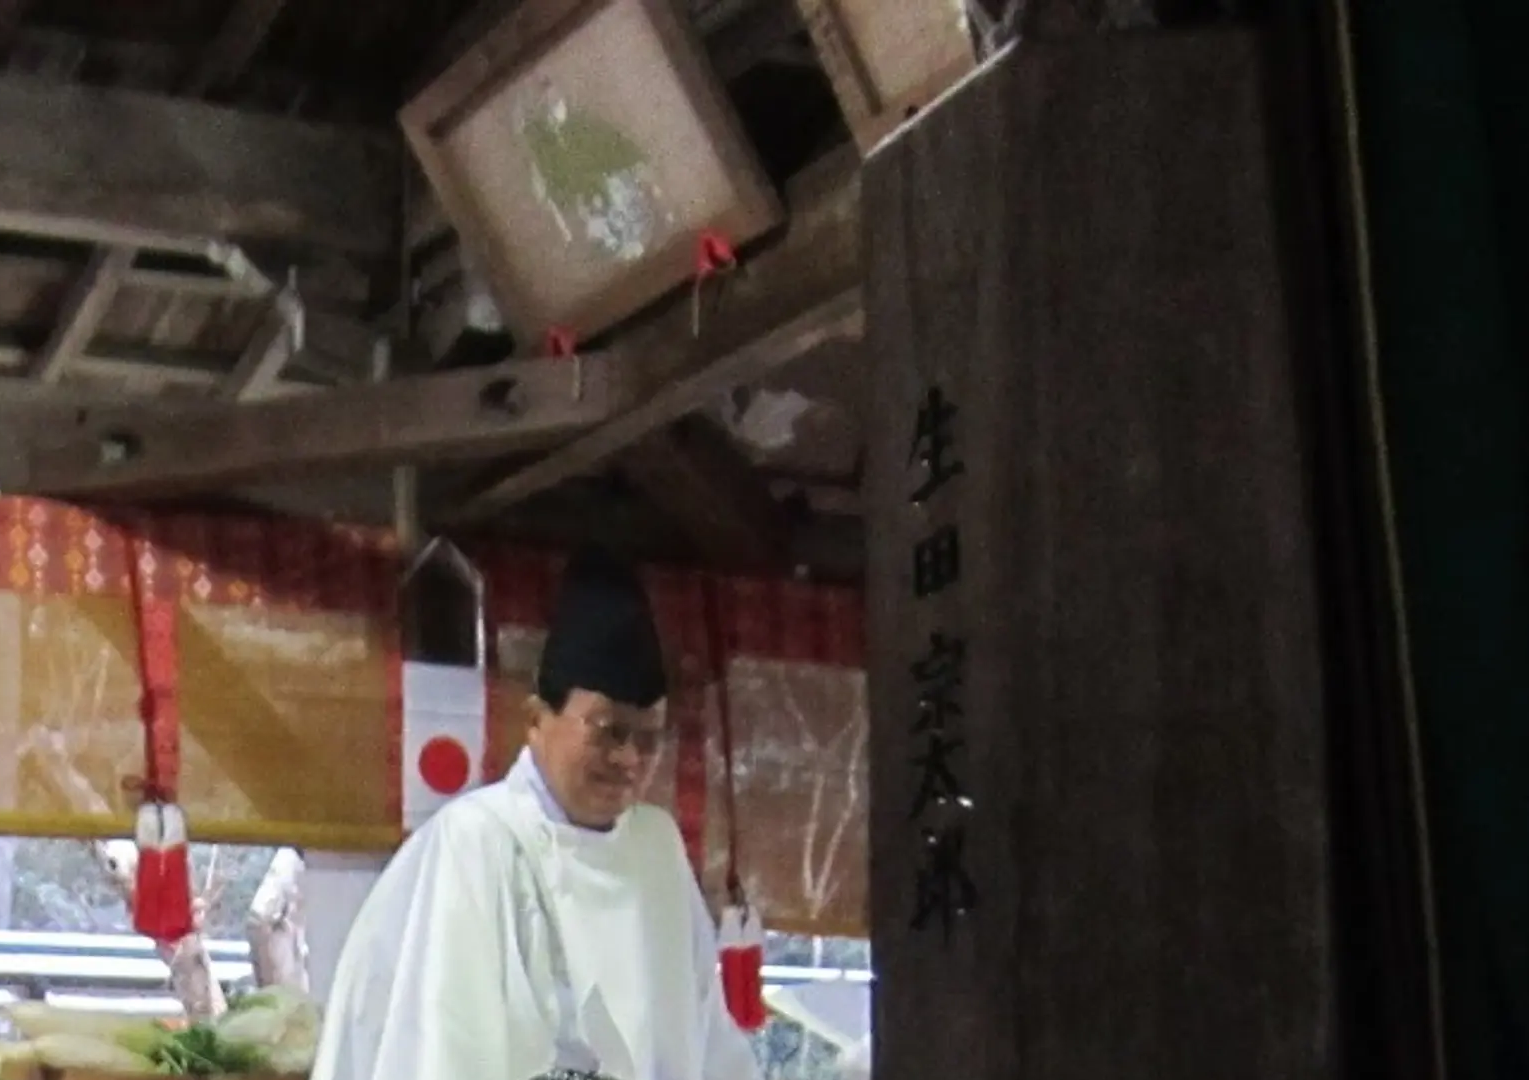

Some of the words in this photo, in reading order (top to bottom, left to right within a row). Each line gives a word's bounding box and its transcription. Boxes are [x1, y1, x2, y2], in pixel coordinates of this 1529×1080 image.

[908, 386, 976, 945] 生田宗太郎
